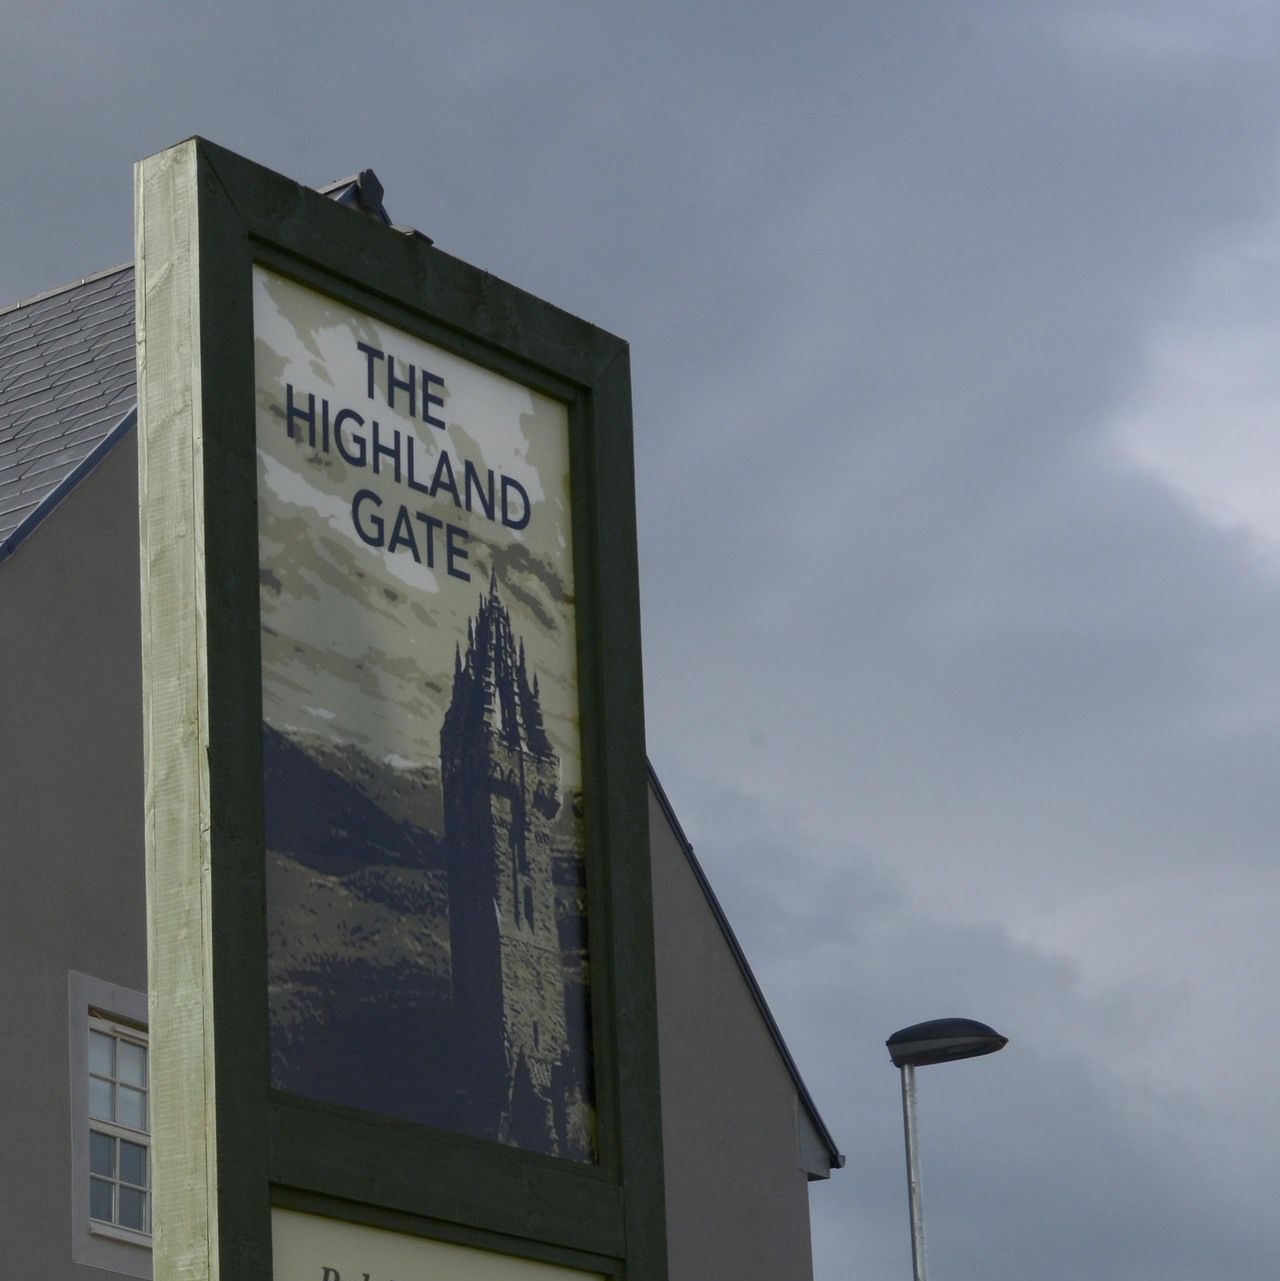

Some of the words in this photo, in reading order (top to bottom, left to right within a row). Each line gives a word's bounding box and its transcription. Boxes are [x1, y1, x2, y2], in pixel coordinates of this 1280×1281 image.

[357, 341, 446, 430] THE
[286, 383, 531, 531] HIGHLAND
[352, 489, 471, 583] GATE
